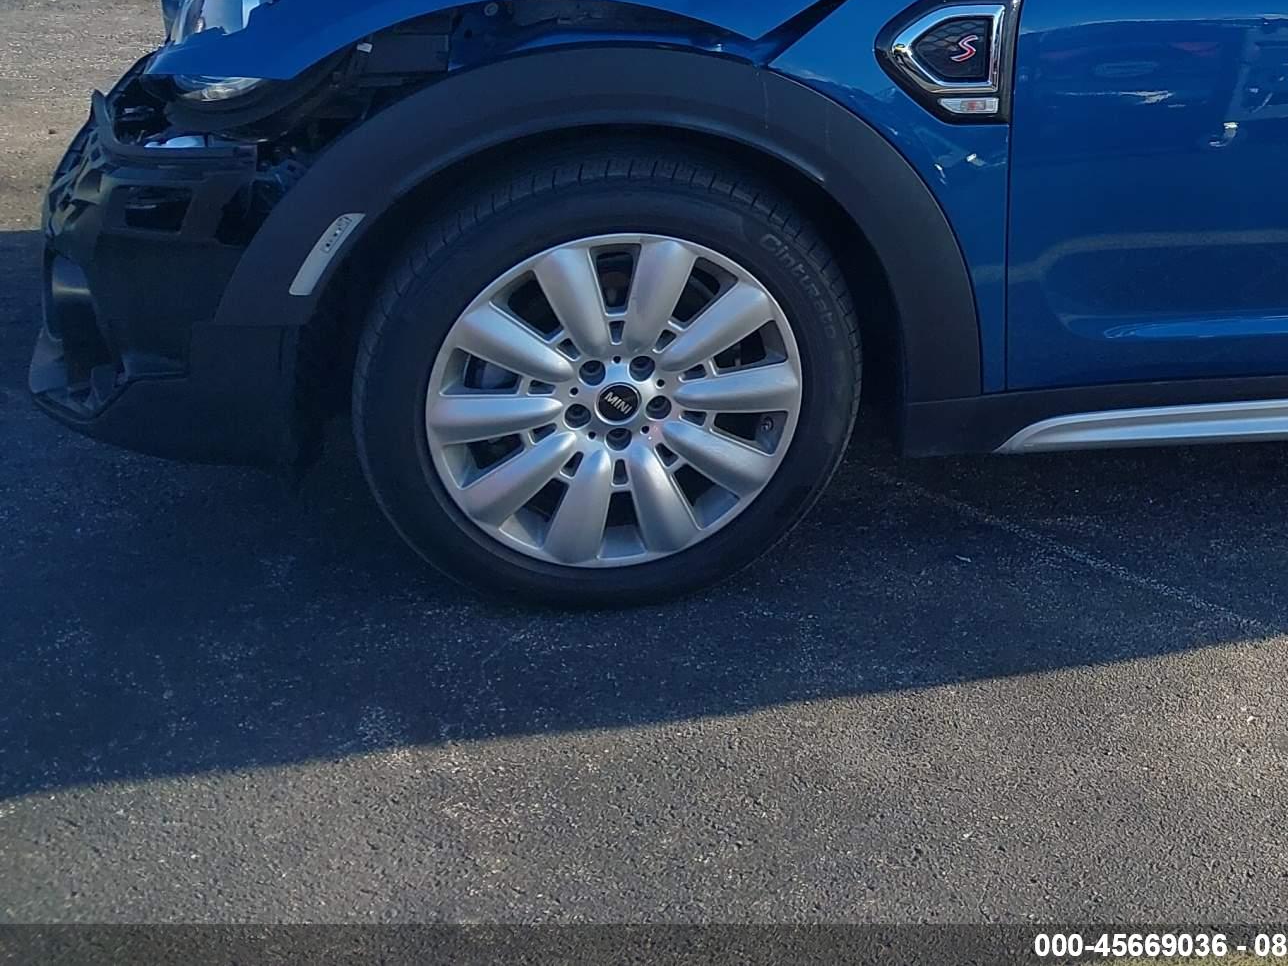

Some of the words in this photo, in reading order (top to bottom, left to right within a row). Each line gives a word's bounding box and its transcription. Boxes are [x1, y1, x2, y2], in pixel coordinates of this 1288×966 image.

[950, 34, 978, 62] S
[759, 232, 837, 340] Cinturato
[603, 391, 633, 414] MINI
